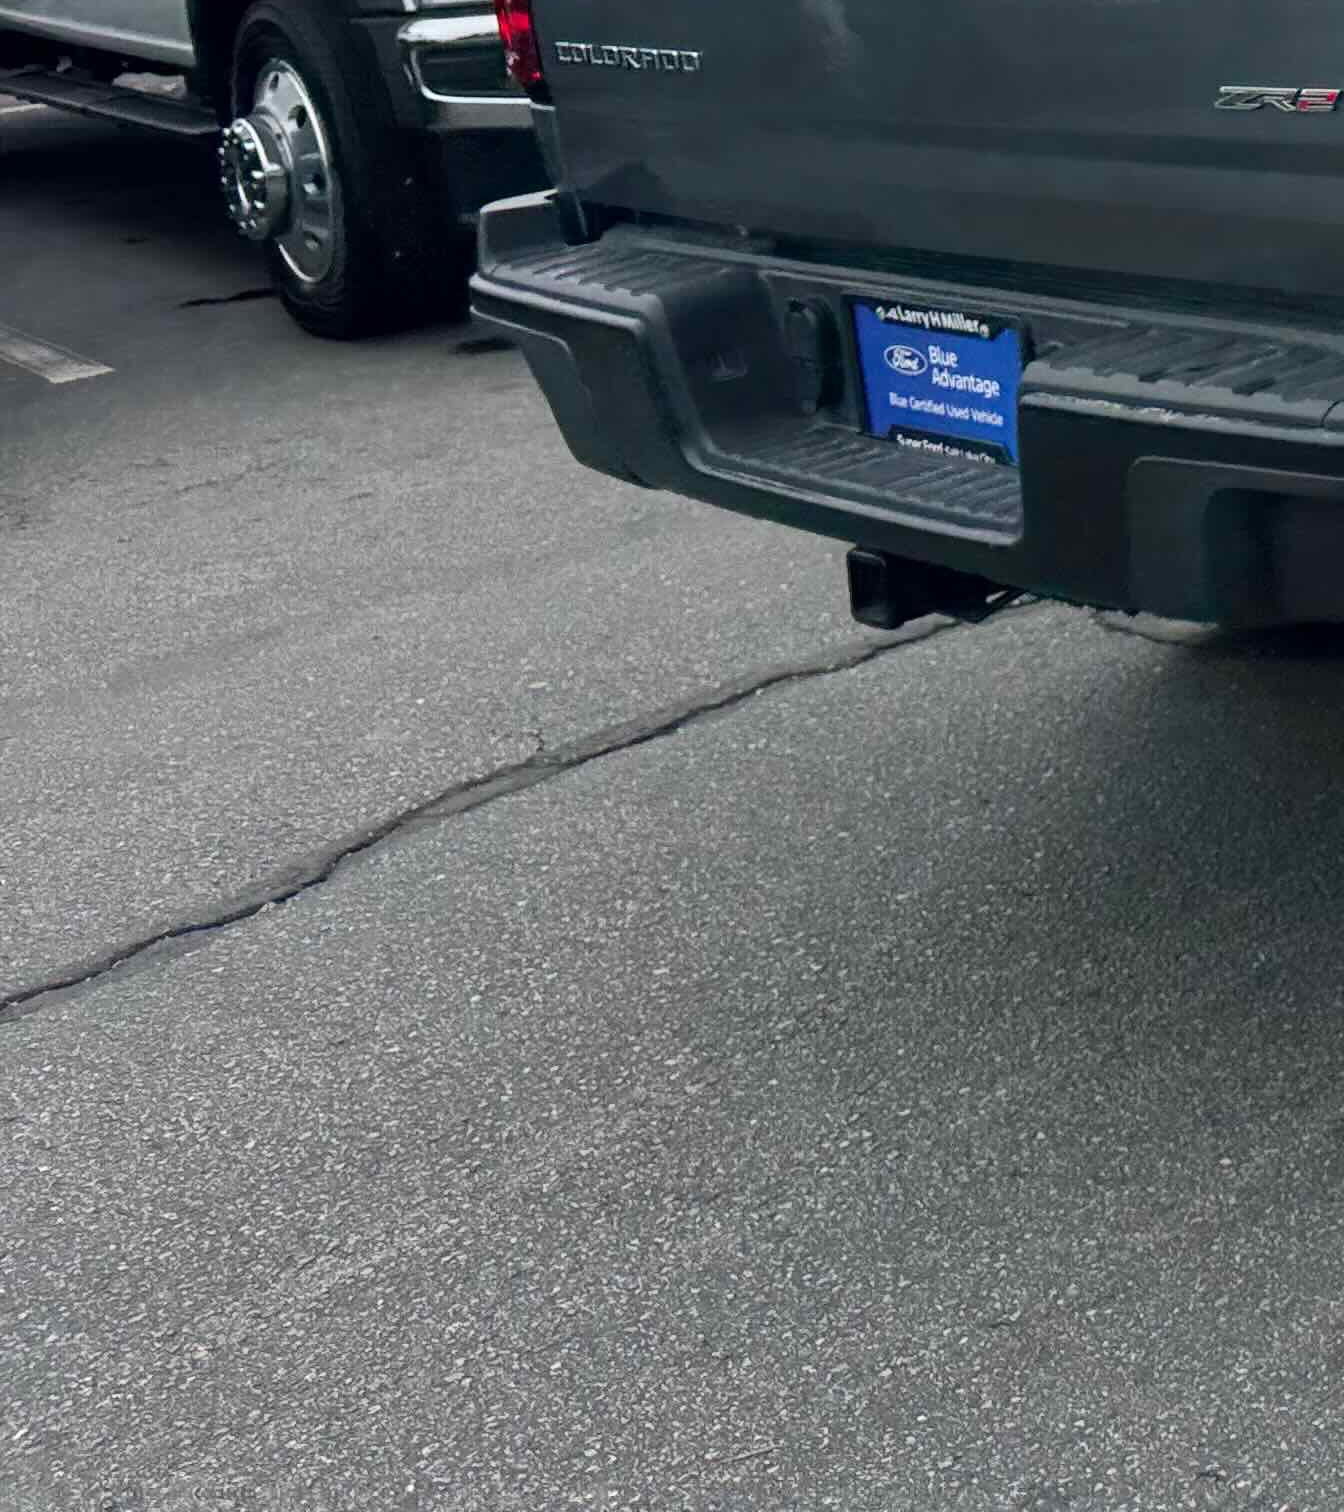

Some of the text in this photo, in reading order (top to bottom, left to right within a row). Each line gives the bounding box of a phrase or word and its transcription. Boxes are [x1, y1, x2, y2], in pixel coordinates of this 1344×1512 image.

[555, 41, 703, 71] COLORADO
[1214, 85, 1343, 112] ZR2
[897, 305, 979, 333] Larry H Miller
[891, 347, 920, 371] Ford
[927, 345, 959, 368] Blue
[931, 368, 1001, 399] Advantage
